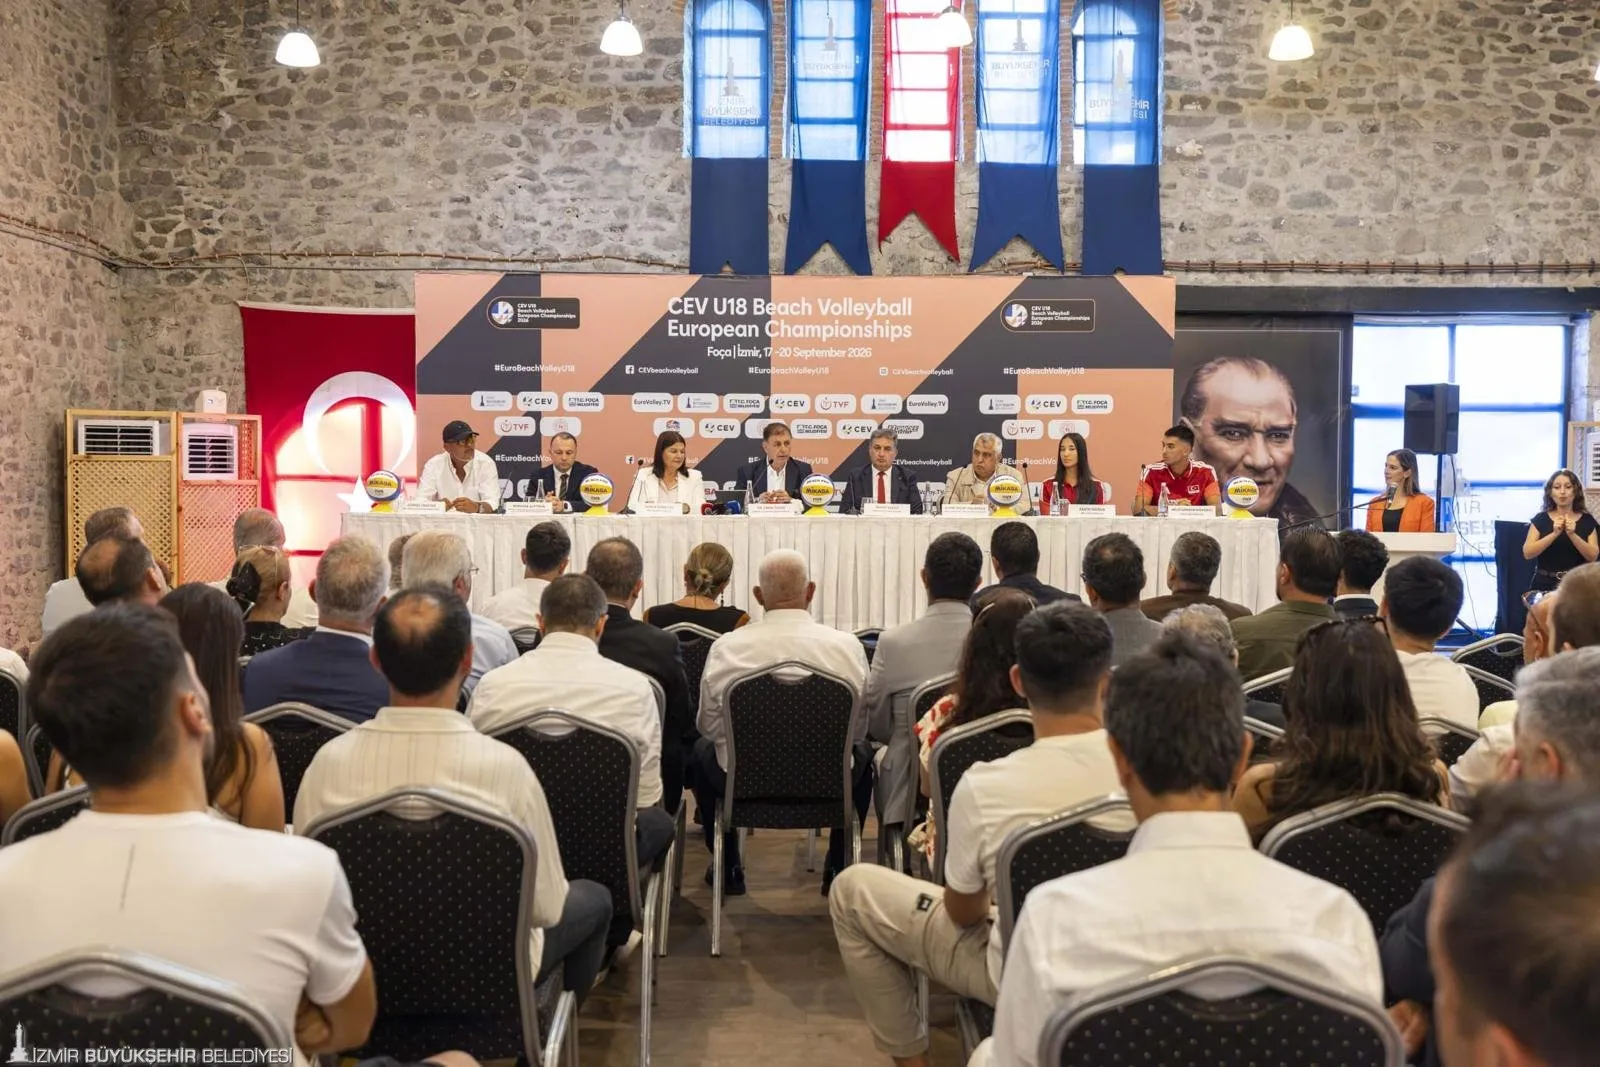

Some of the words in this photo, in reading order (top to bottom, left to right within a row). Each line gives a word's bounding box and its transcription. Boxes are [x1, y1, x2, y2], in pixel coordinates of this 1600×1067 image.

[668, 298, 708, 315] CEV
[713, 298, 748, 315] U18
[753, 298, 812, 316] Beach
[818, 298, 912, 320] Volleyball
[668, 320, 760, 341] European
[765, 320, 912, 342] Championships
[707, 346, 732, 360] Foça
[792, 347, 847, 360] September
[848, 347, 872, 358] 2026
[638, 367, 698, 375] CEVbeachvolleyball
[1003, 367, 1085, 375] #EuroBeachVolleyU18
